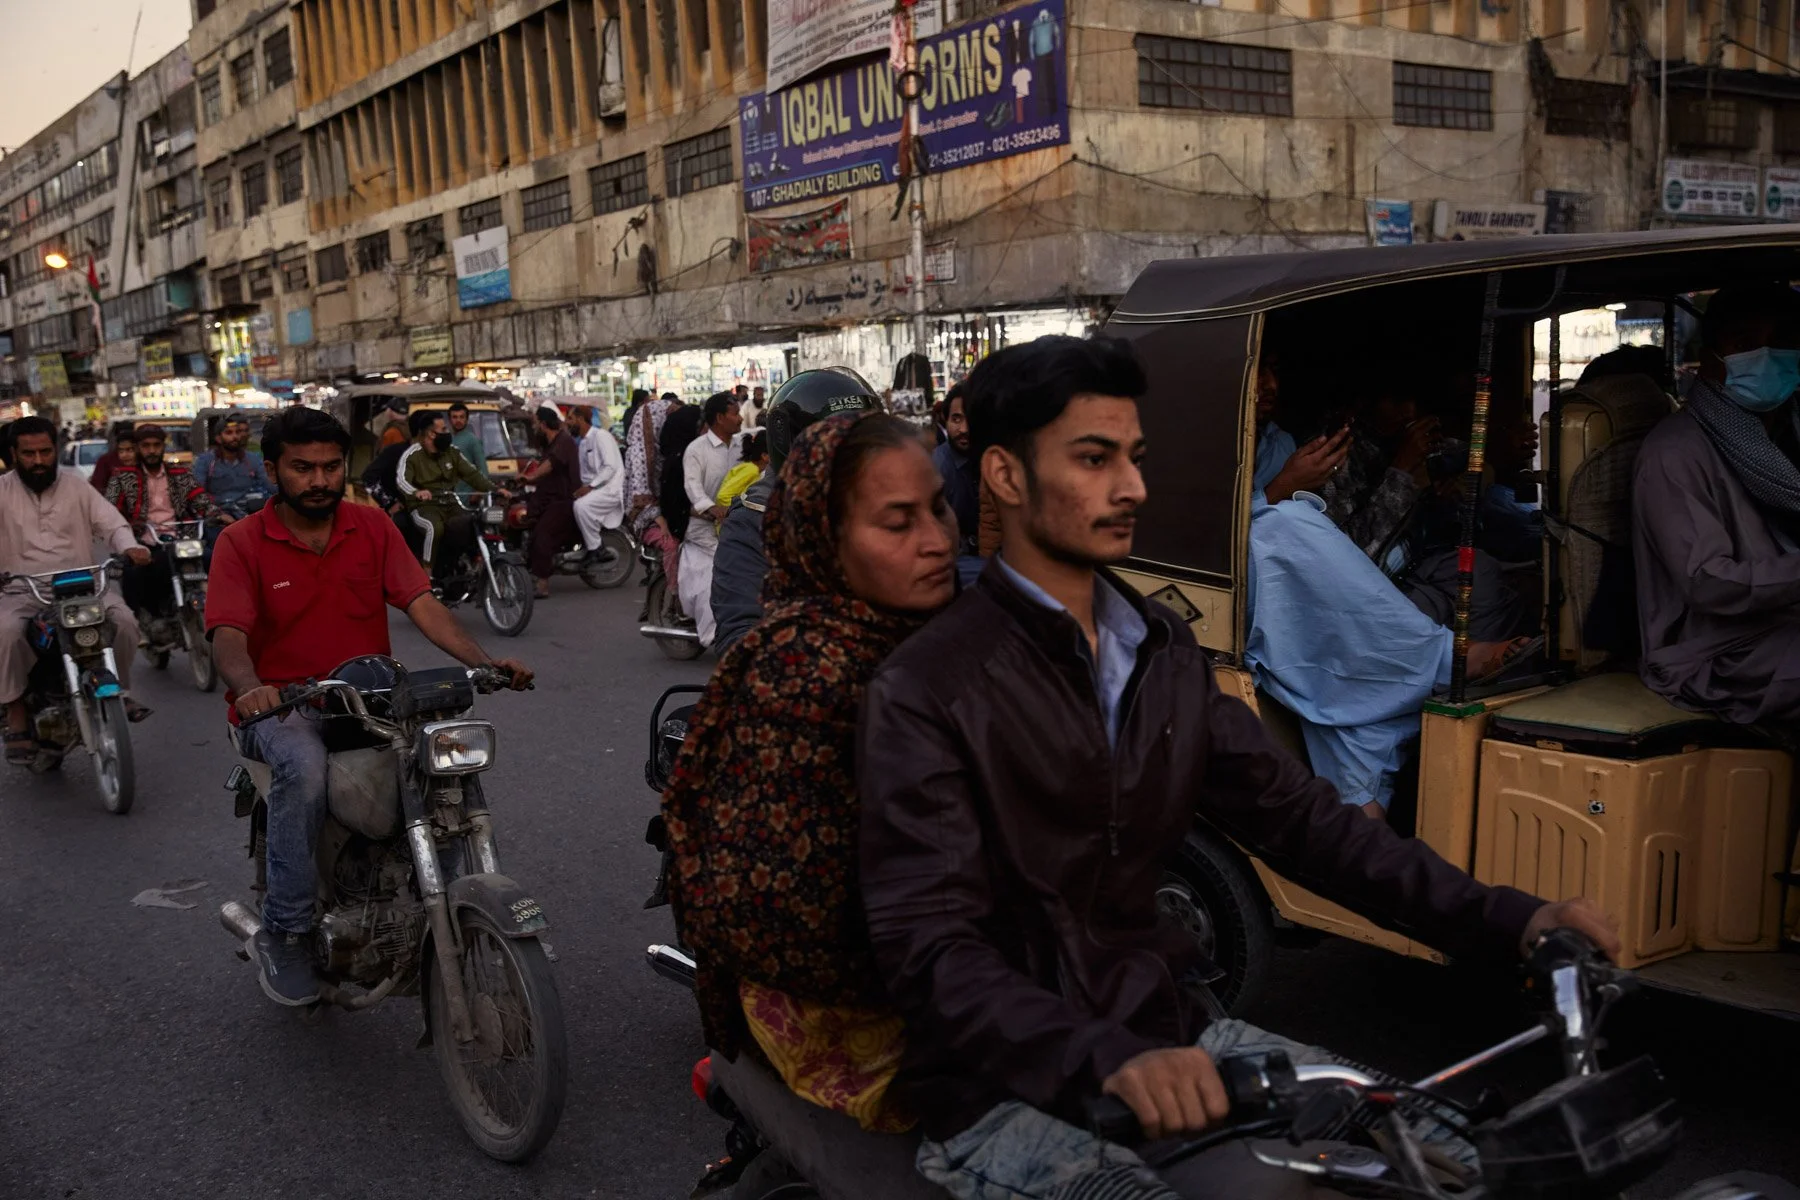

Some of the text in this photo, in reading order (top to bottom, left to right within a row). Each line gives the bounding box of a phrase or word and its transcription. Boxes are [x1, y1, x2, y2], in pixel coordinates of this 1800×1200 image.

[781, 23, 1003, 148] IQBAL UNIORMS
[771, 175, 824, 203] GHADIALY
[826, 163, 881, 192] BUILDING
[1489, 211, 1536, 229] GARMENTS
